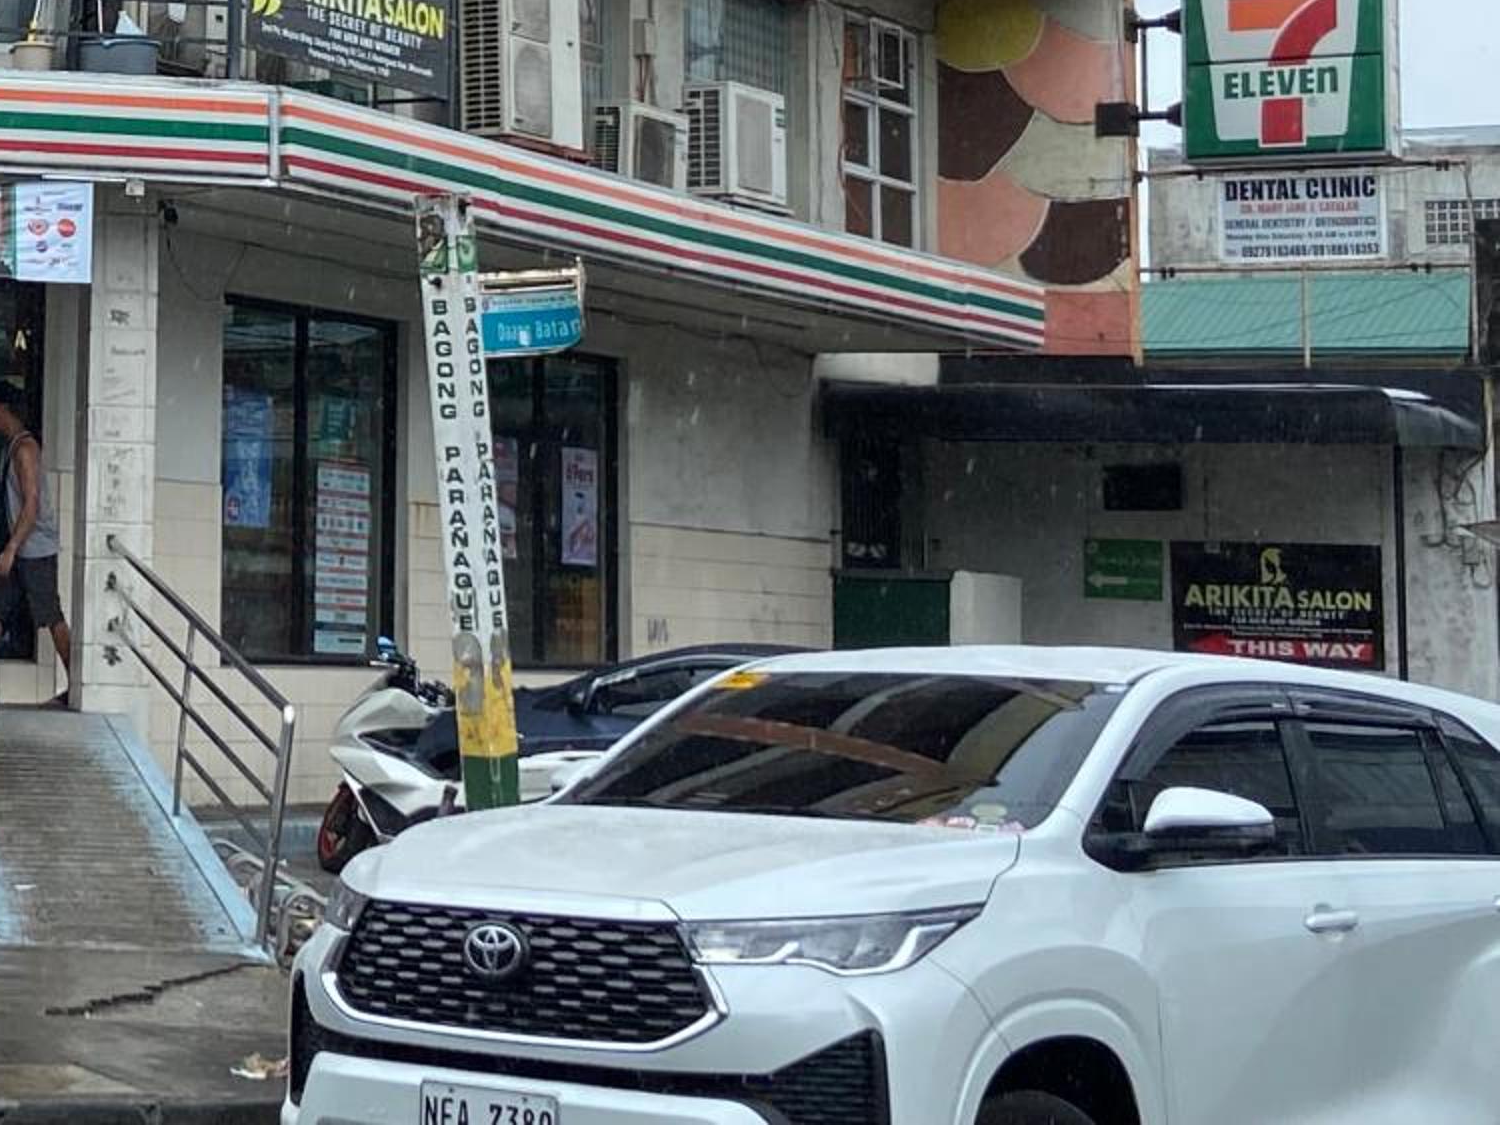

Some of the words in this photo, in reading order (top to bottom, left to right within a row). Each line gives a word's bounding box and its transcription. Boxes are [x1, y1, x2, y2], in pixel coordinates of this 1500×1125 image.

[307, 4, 326, 22] THE
[329, 9, 366, 32] SECRET
[370, 20, 383, 37] OF
[385, 25, 423, 49] BEAUTY
[1224, 177, 1301, 201] DENTAL
[1306, 175, 1376, 199] CLINIC
[1262, 218, 1305, 229] DENTISTRY
[431, 300, 457, 419] BAGONG
[464, 297, 485, 417] BAGONG
[1185, 584, 1294, 609] ARIKITA
[1298, 590, 1371, 611] SALON
[1227, 639, 1295, 657] THIS
[1302, 641, 1366, 660] WAY
